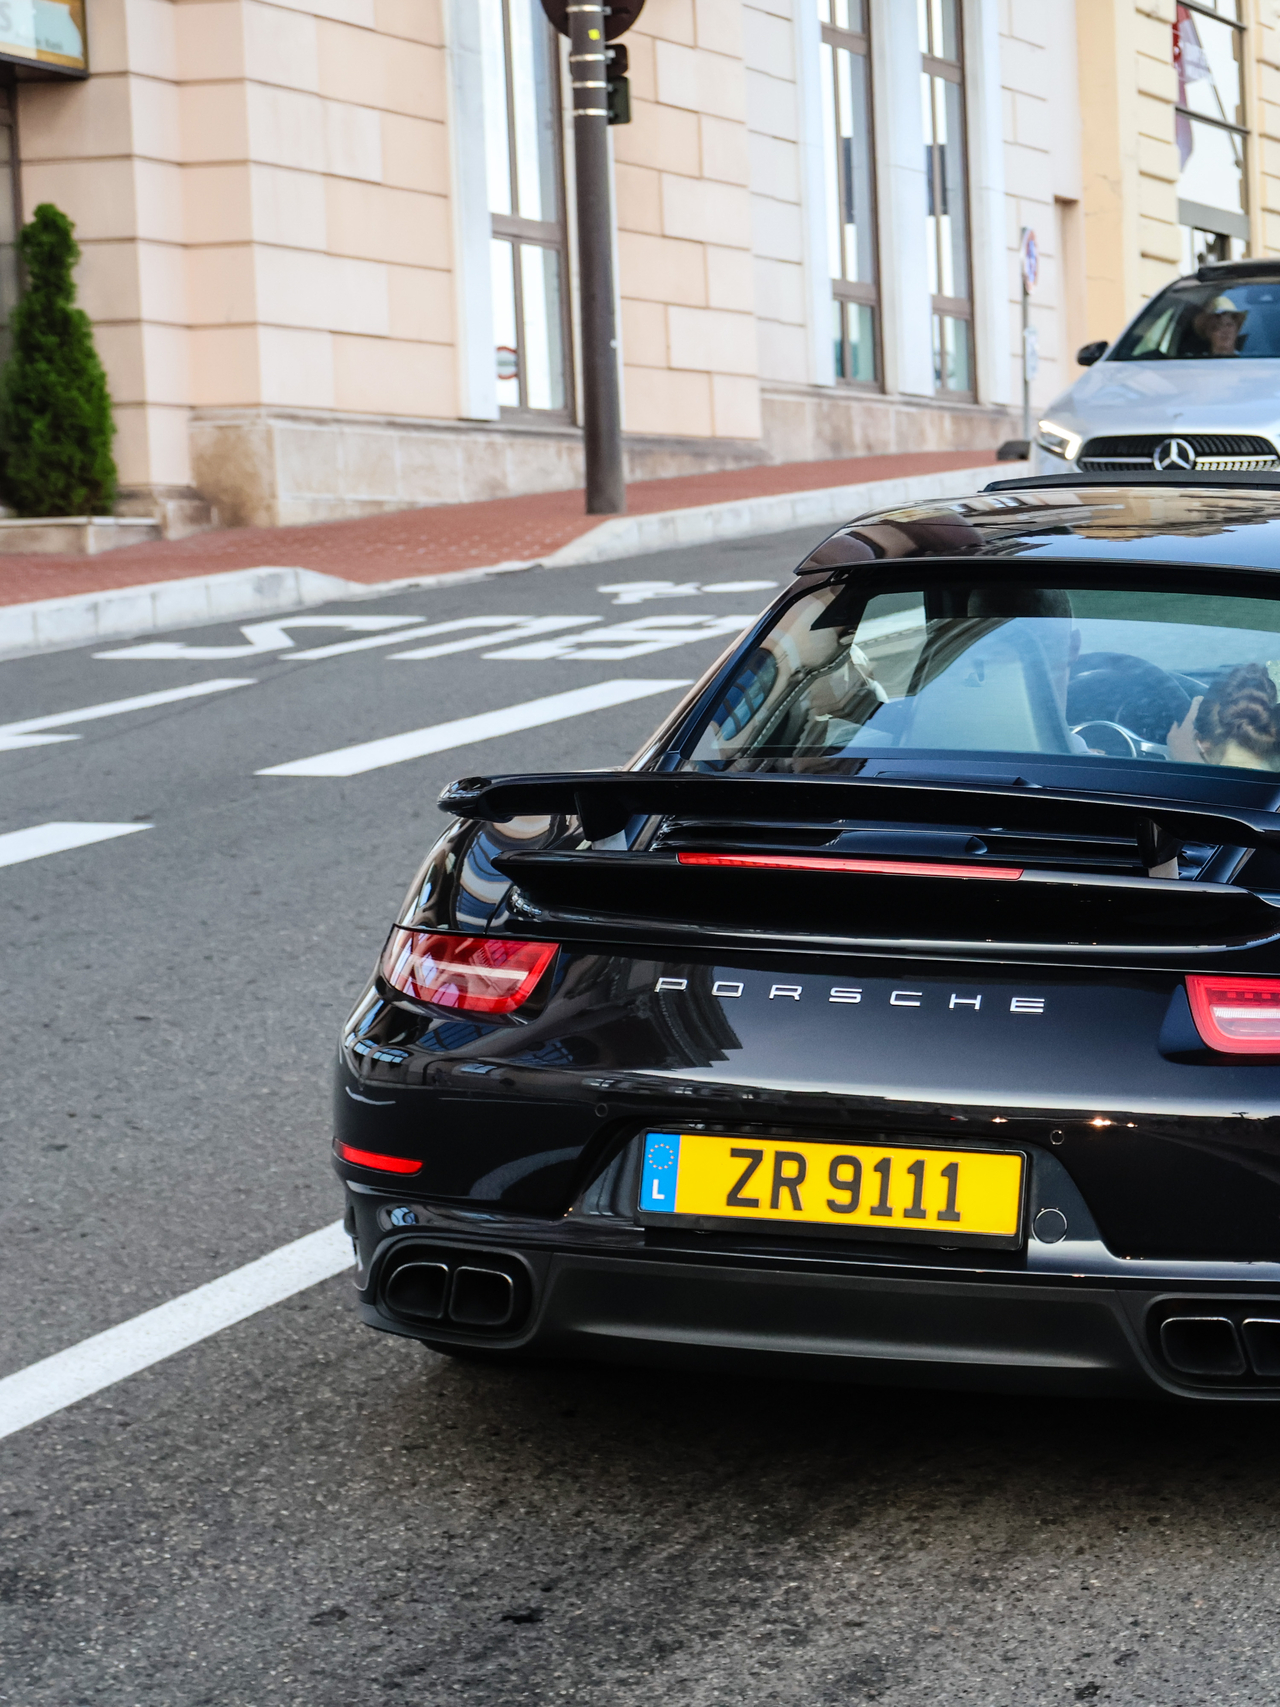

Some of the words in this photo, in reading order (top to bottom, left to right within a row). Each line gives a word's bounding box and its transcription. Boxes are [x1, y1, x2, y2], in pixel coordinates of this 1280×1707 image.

[654, 977, 1046, 1014] PORSCHE
[651, 1179, 665, 1200] L
[726, 1147, 808, 1212] ZR
[826, 1154, 962, 1223] 9111
